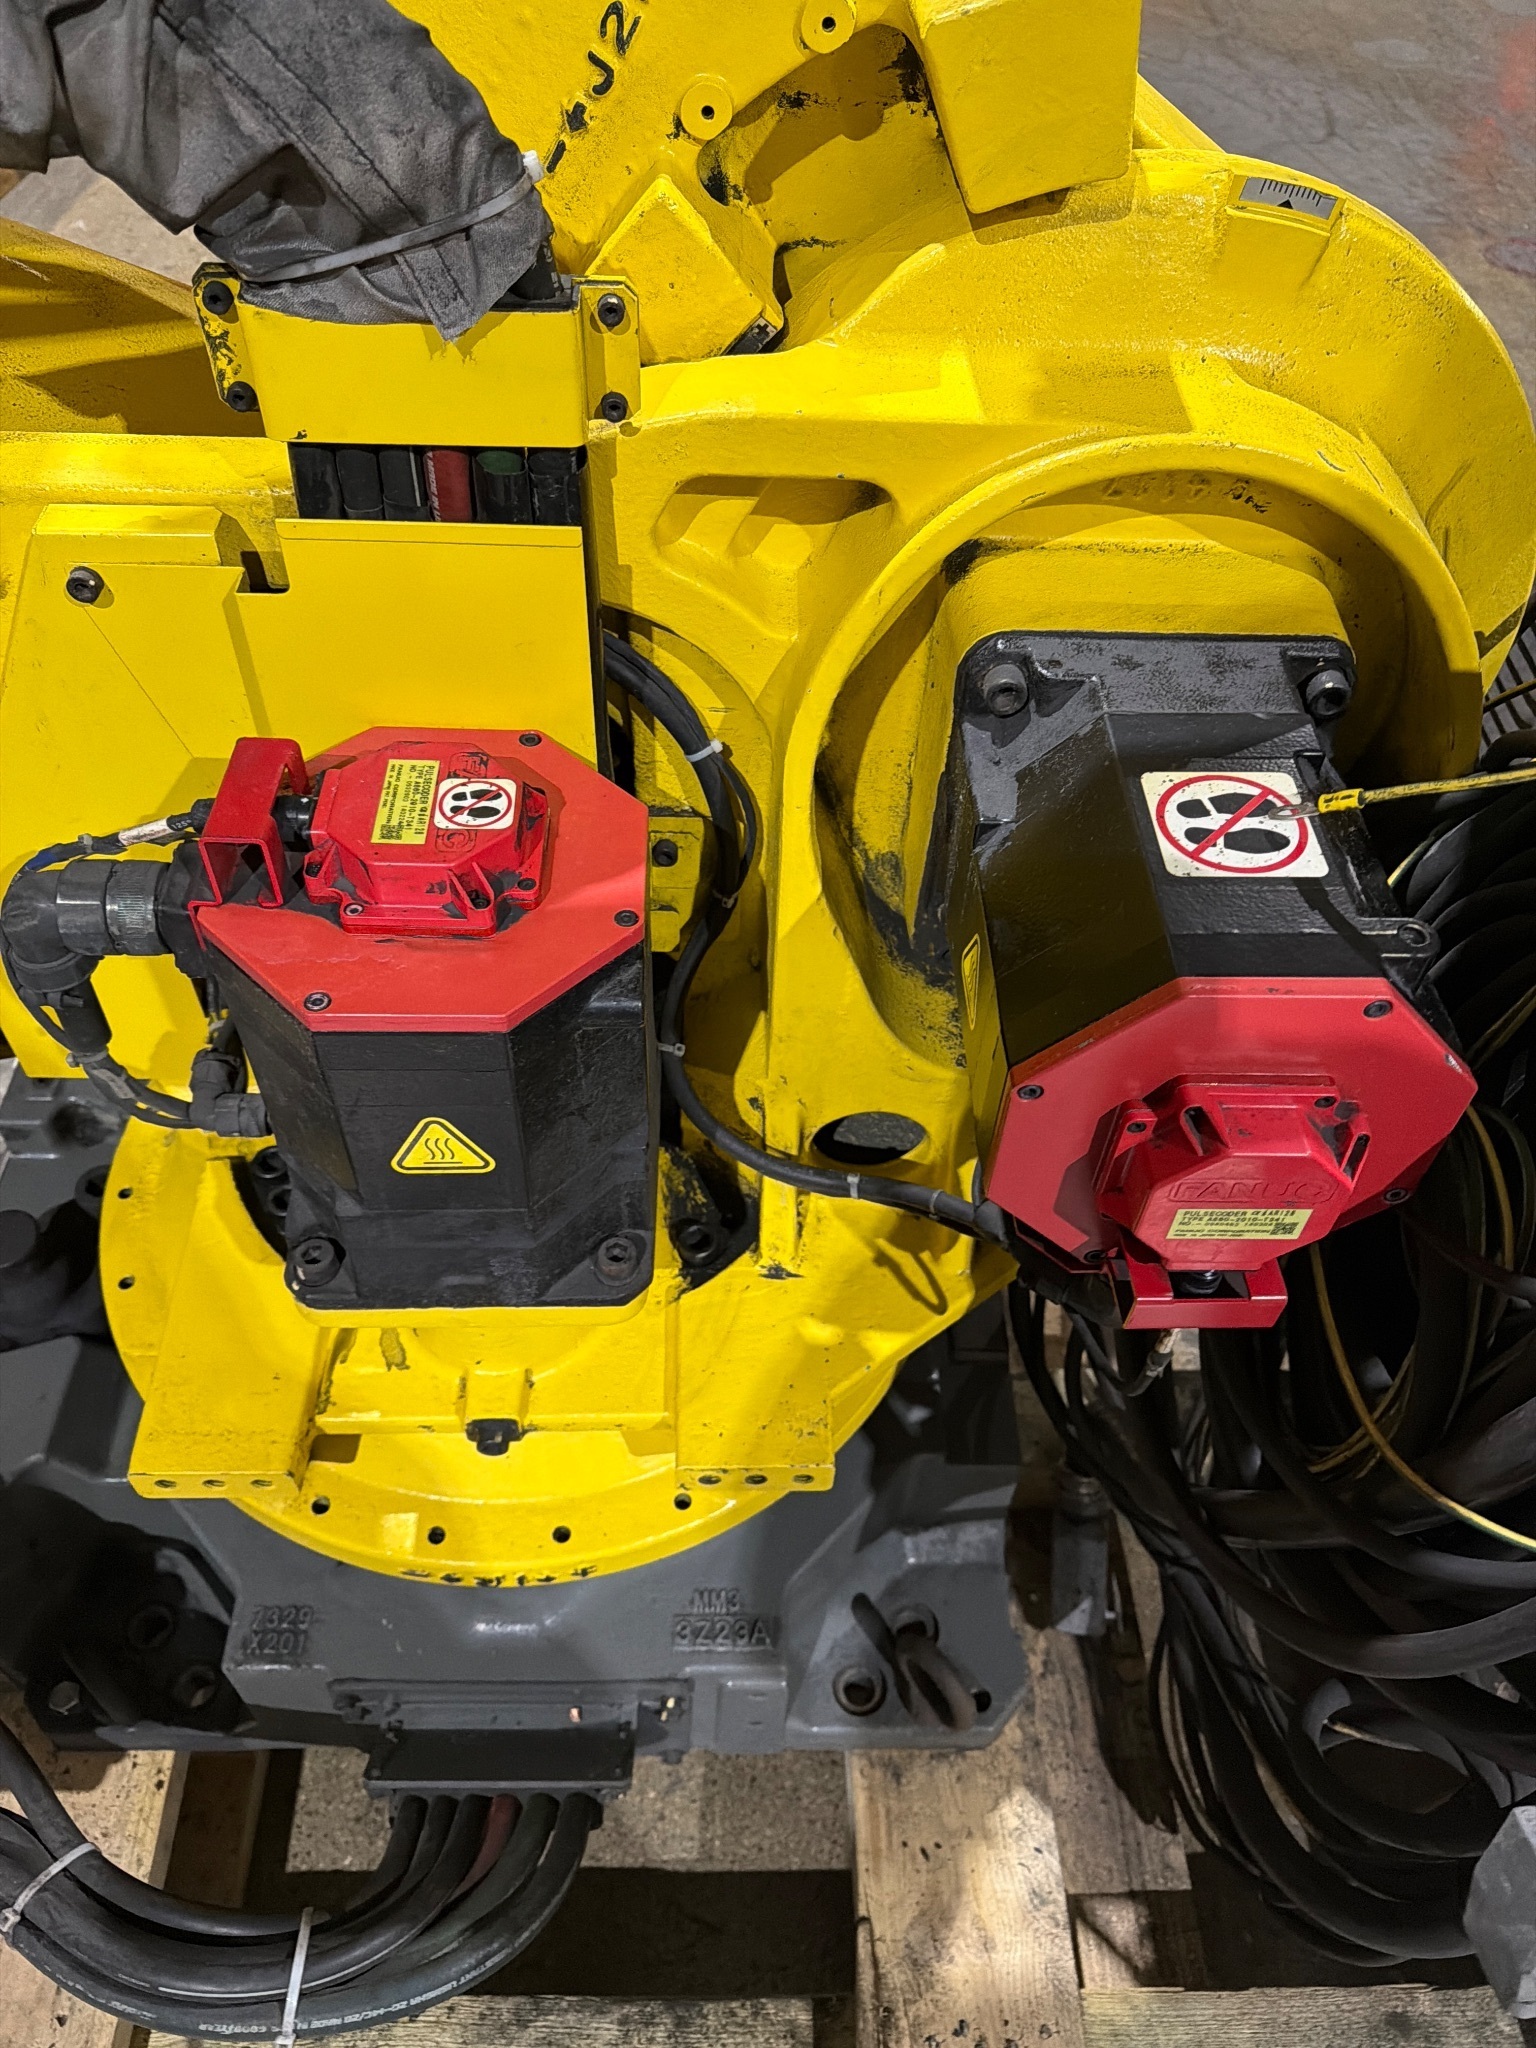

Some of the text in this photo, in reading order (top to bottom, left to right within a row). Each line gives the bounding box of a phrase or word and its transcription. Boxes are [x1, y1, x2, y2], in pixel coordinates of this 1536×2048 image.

[587, 1, 642, 96] J2
[415, 765, 425, 779] TYPE
[420, 765, 435, 804] PULSECODER
[385, 784, 399, 823] CORPORATION
[1174, 1182, 1325, 1199] FANUC
[198, 2024, 267, 2035] GOODYEAR
